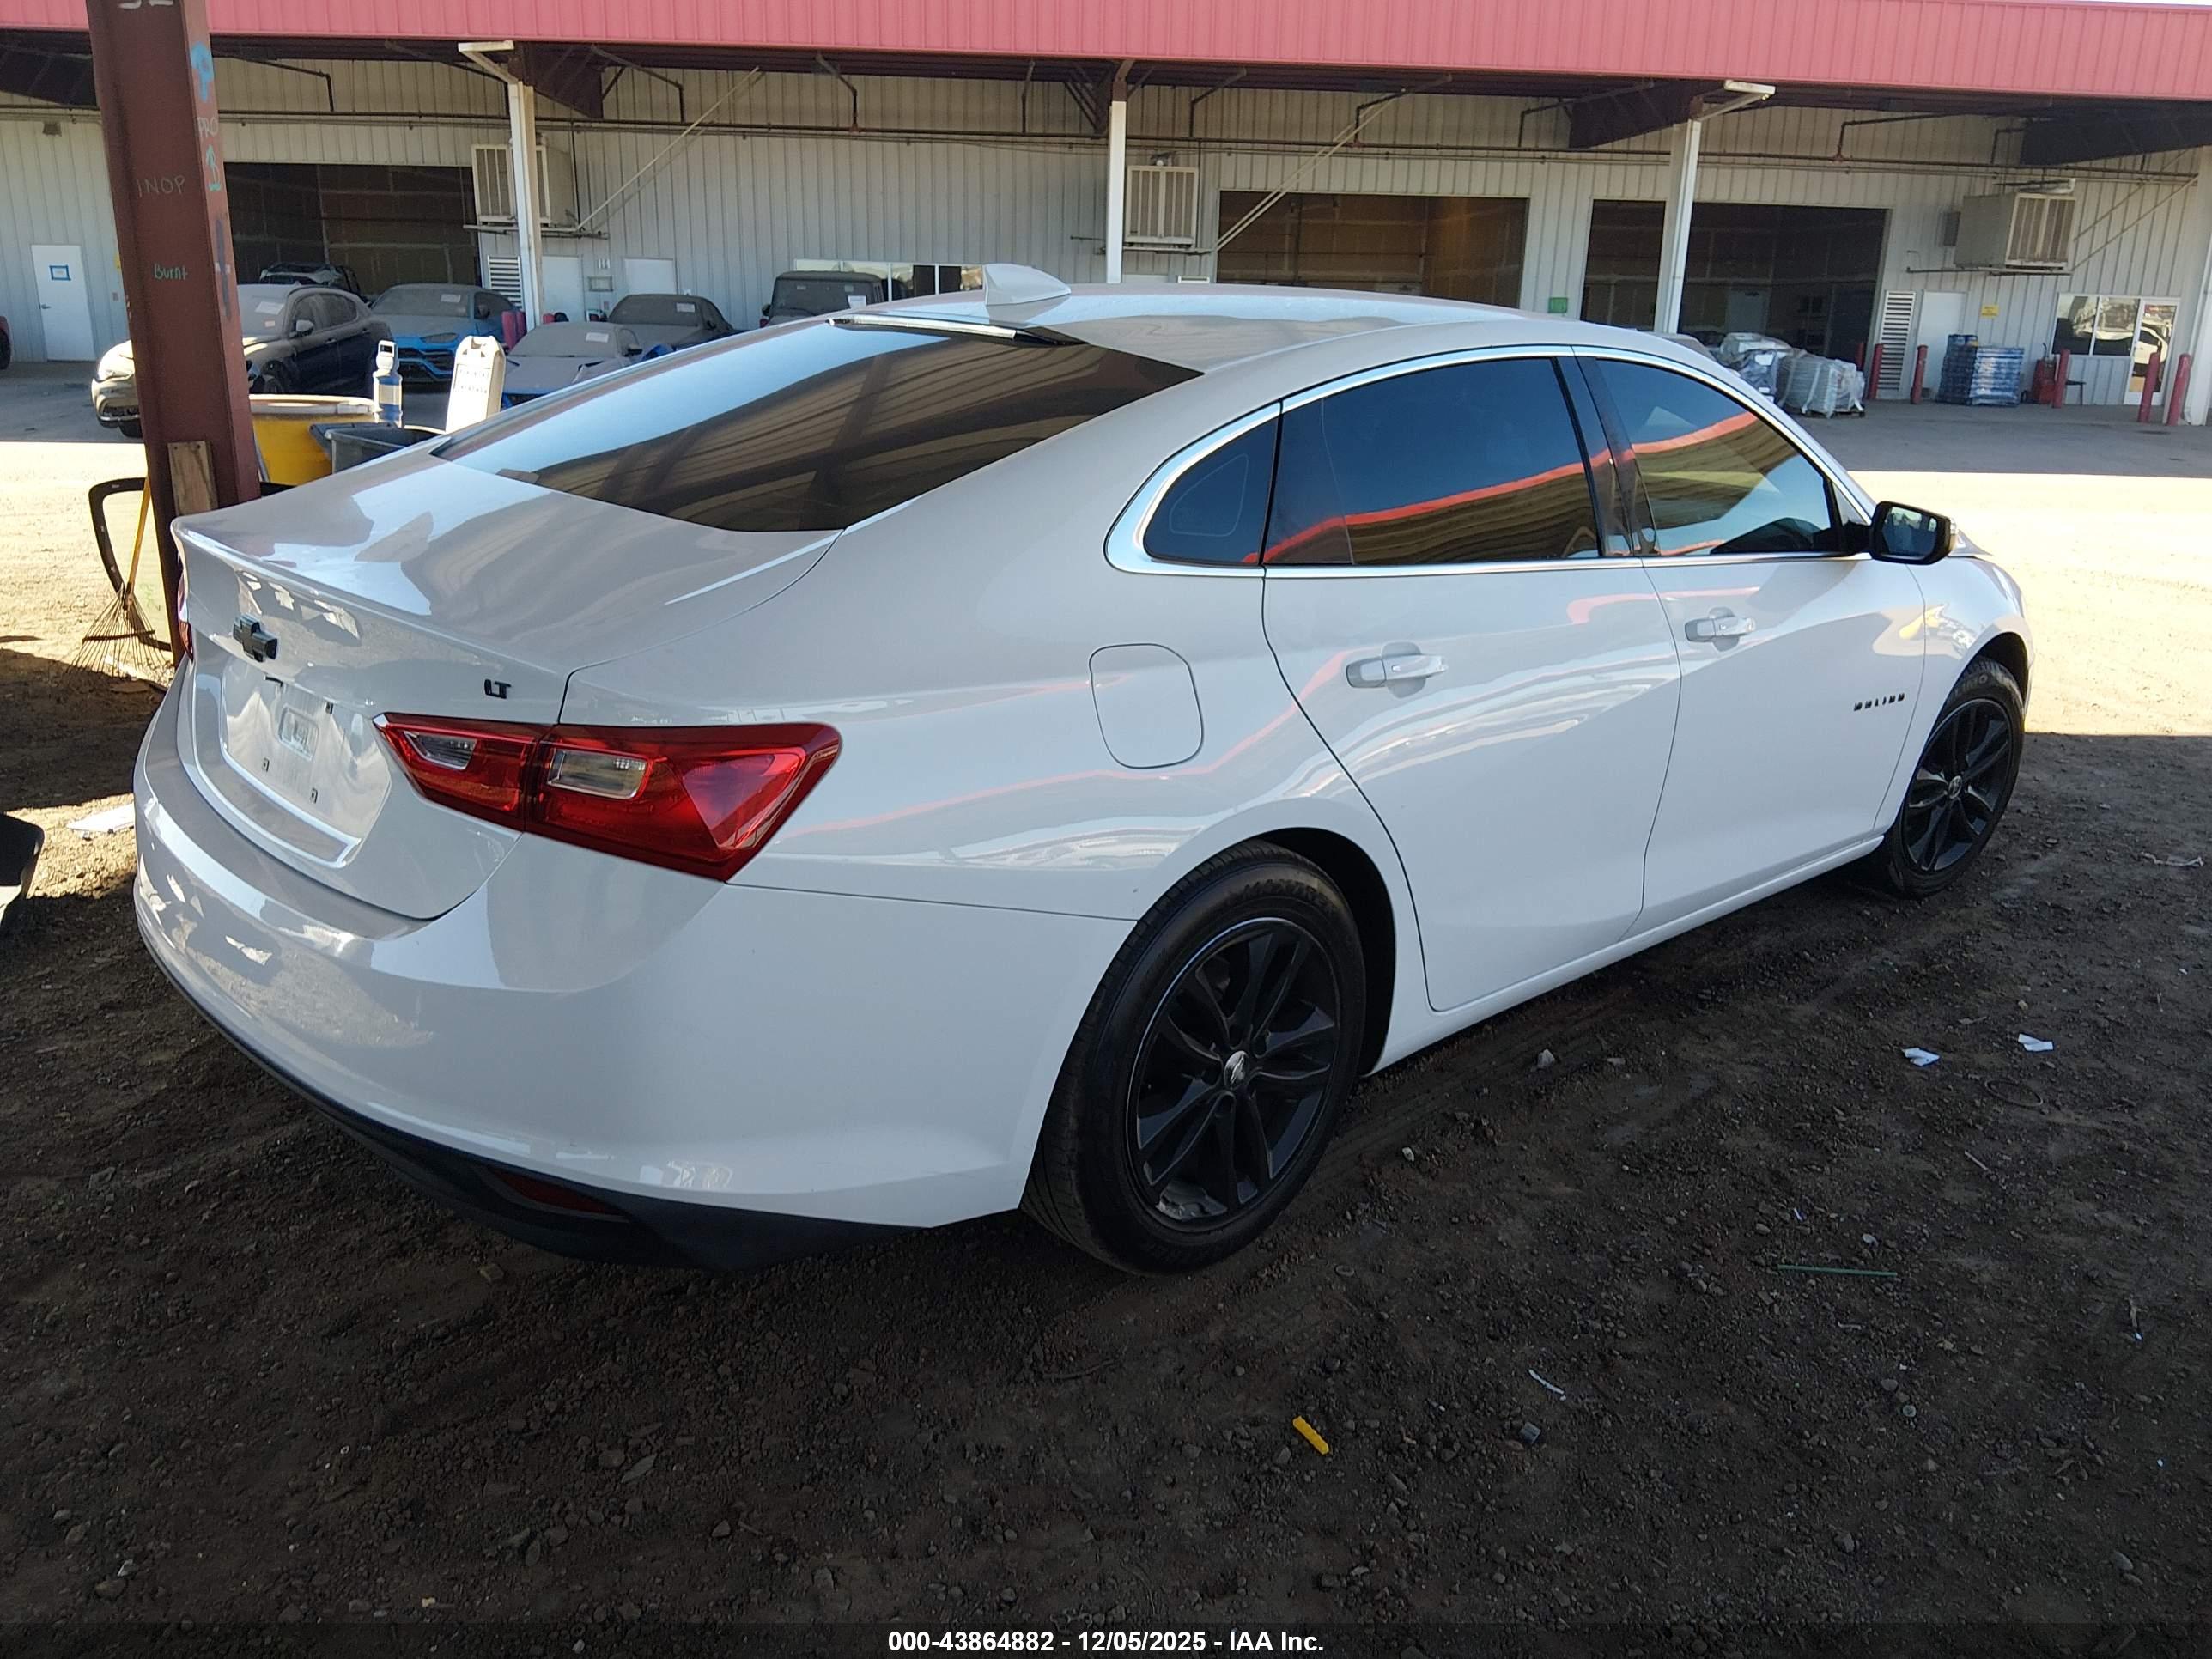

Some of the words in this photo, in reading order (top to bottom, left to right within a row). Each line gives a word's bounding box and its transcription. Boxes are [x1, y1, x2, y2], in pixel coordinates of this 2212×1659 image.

[137, 174, 185, 198] INOP
[154, 262, 188, 281] Burnt
[483, 678, 512, 699] LT
